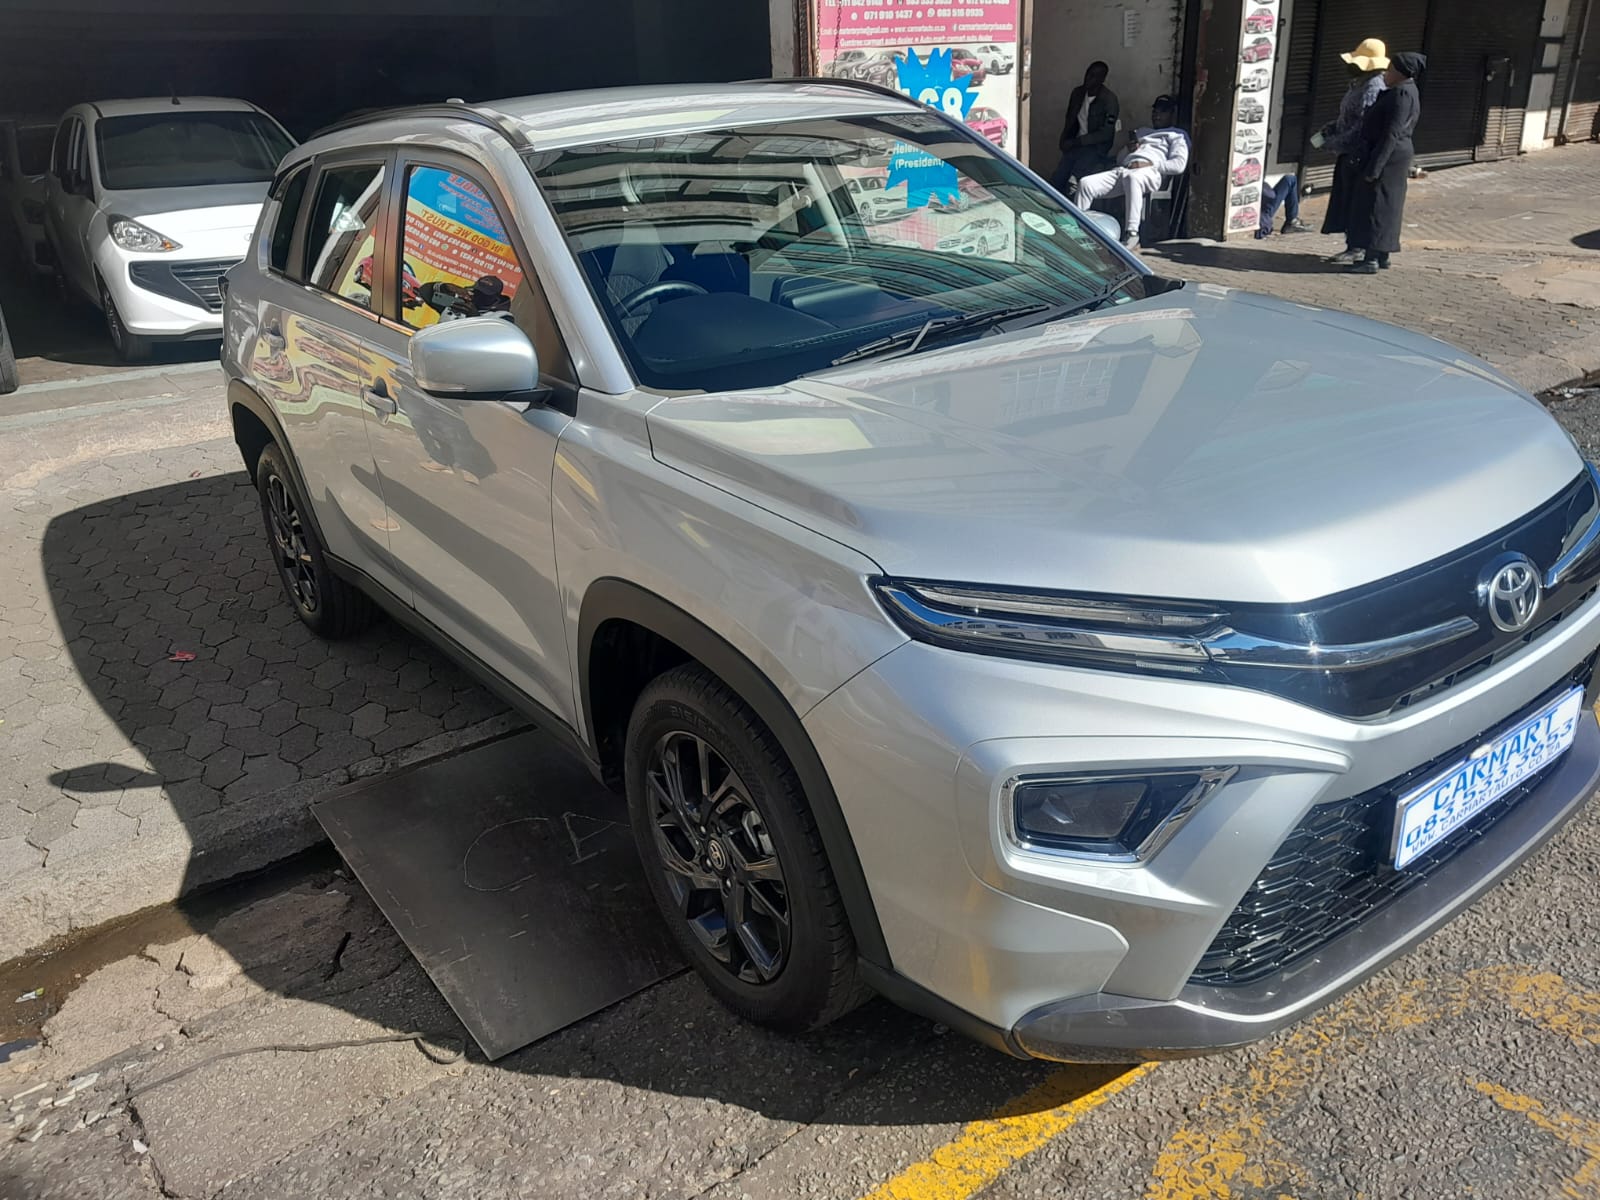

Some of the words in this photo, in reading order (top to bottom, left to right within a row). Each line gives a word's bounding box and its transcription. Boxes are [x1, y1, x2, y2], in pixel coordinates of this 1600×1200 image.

[1405, 801, 1455, 849] 083
[1462, 763, 1510, 806] 533
[1517, 718, 1574, 768] 3653
[1433, 708, 1559, 811] CARMART
